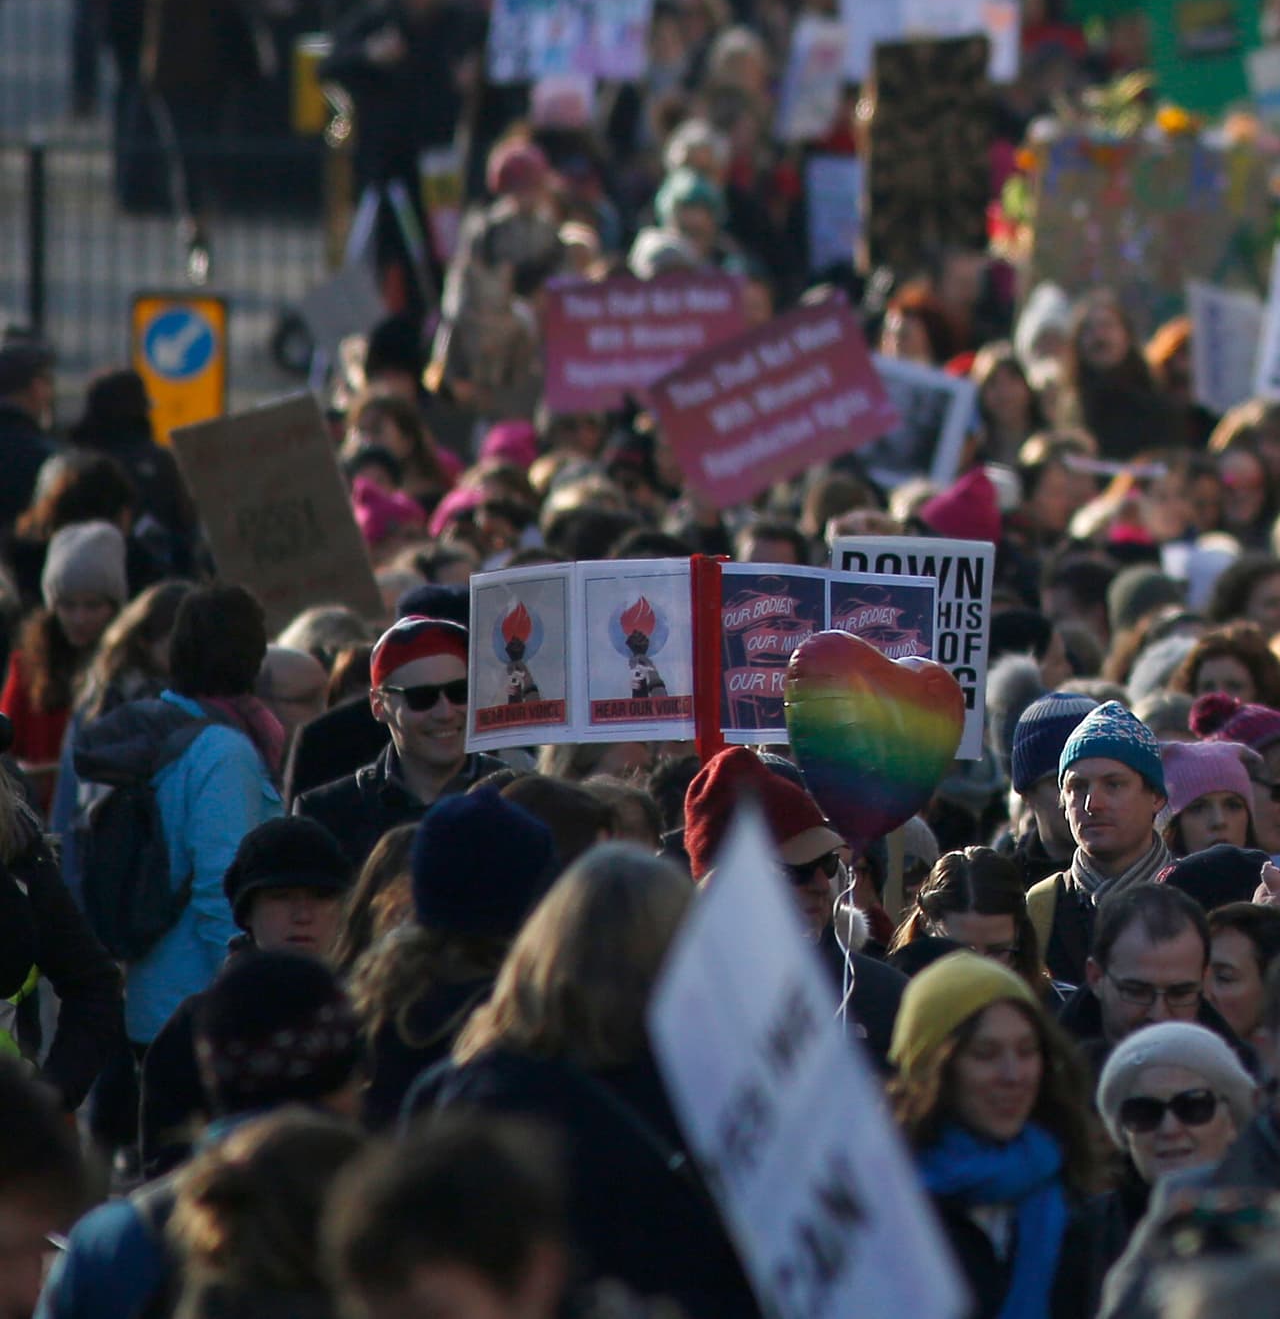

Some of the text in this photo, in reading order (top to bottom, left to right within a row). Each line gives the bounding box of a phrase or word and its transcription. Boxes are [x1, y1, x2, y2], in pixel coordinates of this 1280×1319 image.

[724, 597, 793, 627] OUR BODIES
[858, 607, 896, 627] BODIES
[747, 634, 777, 651] OUR
[729, 673, 765, 691] OUR
[595, 698, 690, 717] HEAR OUR VOICE
